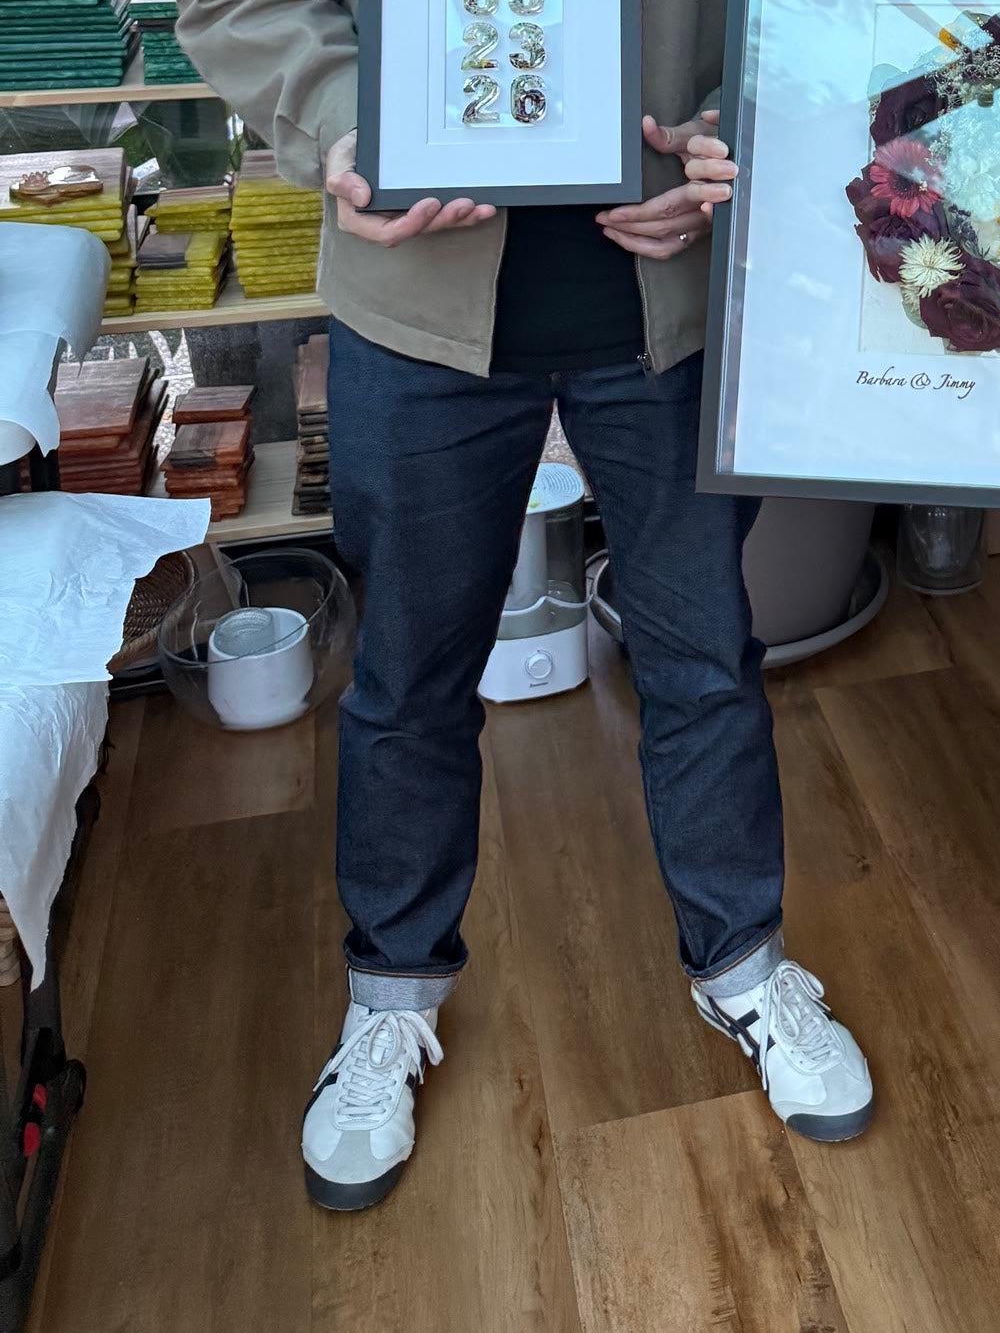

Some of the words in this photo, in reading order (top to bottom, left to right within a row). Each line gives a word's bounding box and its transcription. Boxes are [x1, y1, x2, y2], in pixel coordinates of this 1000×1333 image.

[856, 366, 907, 387] Barbara
[910, 372, 931, 390] &
[933, 373, 976, 399] Jimmy
